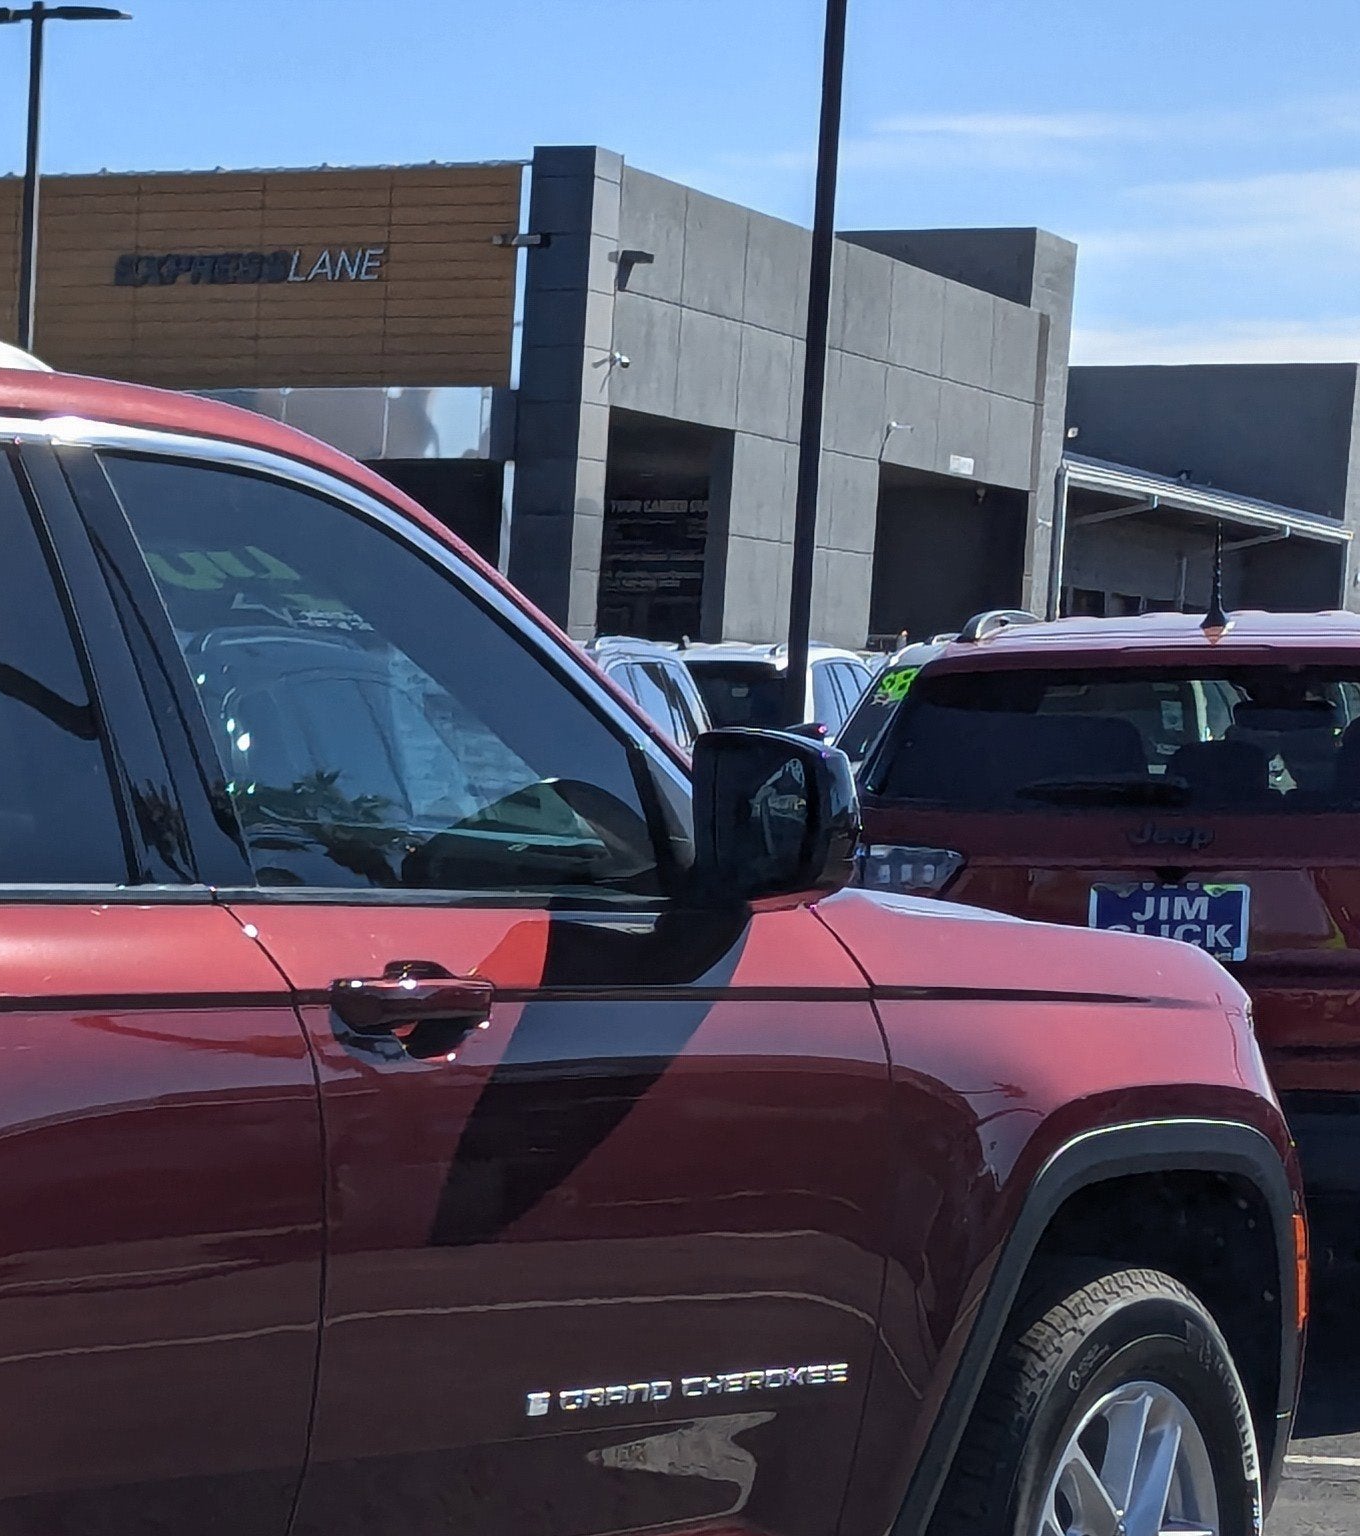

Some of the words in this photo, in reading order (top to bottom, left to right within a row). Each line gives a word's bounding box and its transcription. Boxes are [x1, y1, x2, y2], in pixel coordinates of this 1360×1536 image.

[287, 249, 384, 282] LANE
[1129, 822, 1215, 849] Jeep
[1132, 896, 1210, 921] JIM
[1105, 924, 1233, 948] ICK
[559, 1380, 673, 1411] GRAND
[681, 1363, 849, 1398] CHEROKEE
